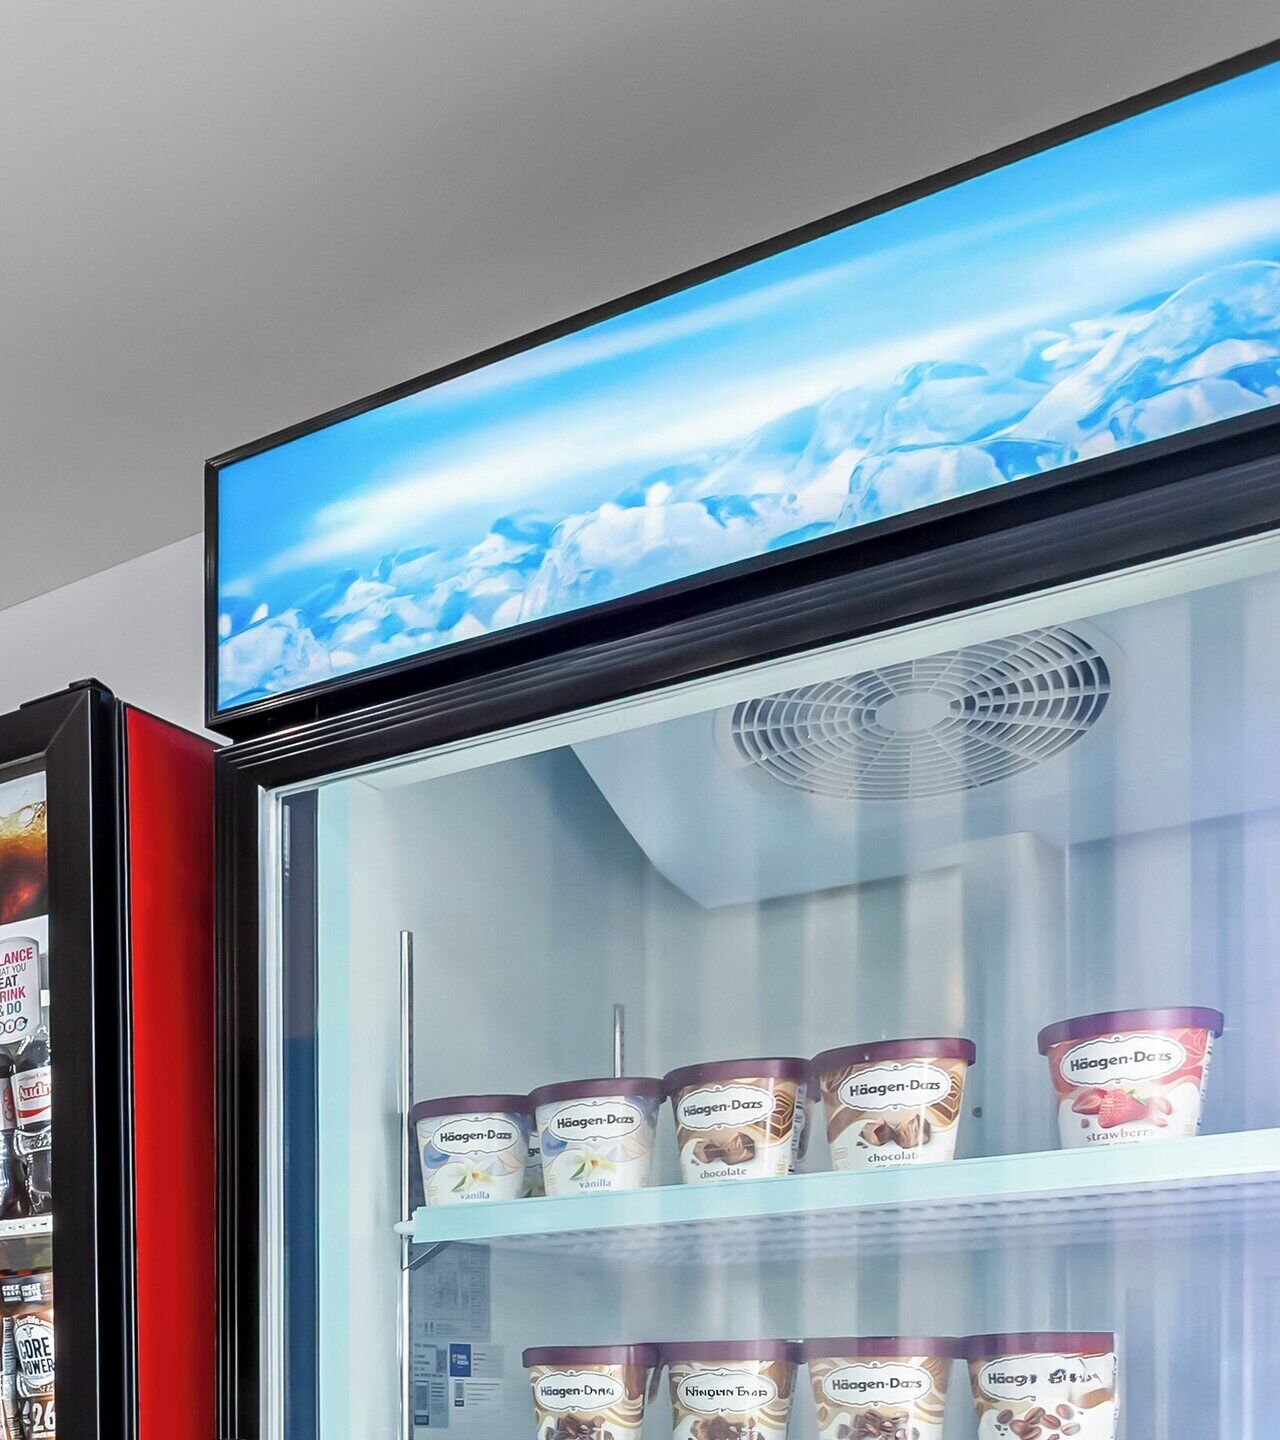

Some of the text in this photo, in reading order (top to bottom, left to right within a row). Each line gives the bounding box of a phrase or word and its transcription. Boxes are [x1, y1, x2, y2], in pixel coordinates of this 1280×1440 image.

[12, 963, 27, 974] YOU
[6, 1001, 22, 1015] DO
[1070, 1050, 1173, 1073] Häagen-Dazs
[849, 1079, 942, 1097] Häagen-Dazs
[683, 1099, 763, 1118] Häagen-Dazs
[557, 1113, 635, 1131] Häagen-Dazs
[440, 1129, 513, 1145] Häagen-Dazs
[699, 1166, 748, 1180] chocolate
[578, 1178, 612, 1189] vanilla
[460, 1190, 491, 1200] vanilla
[19, 1337, 52, 1359] CORE
